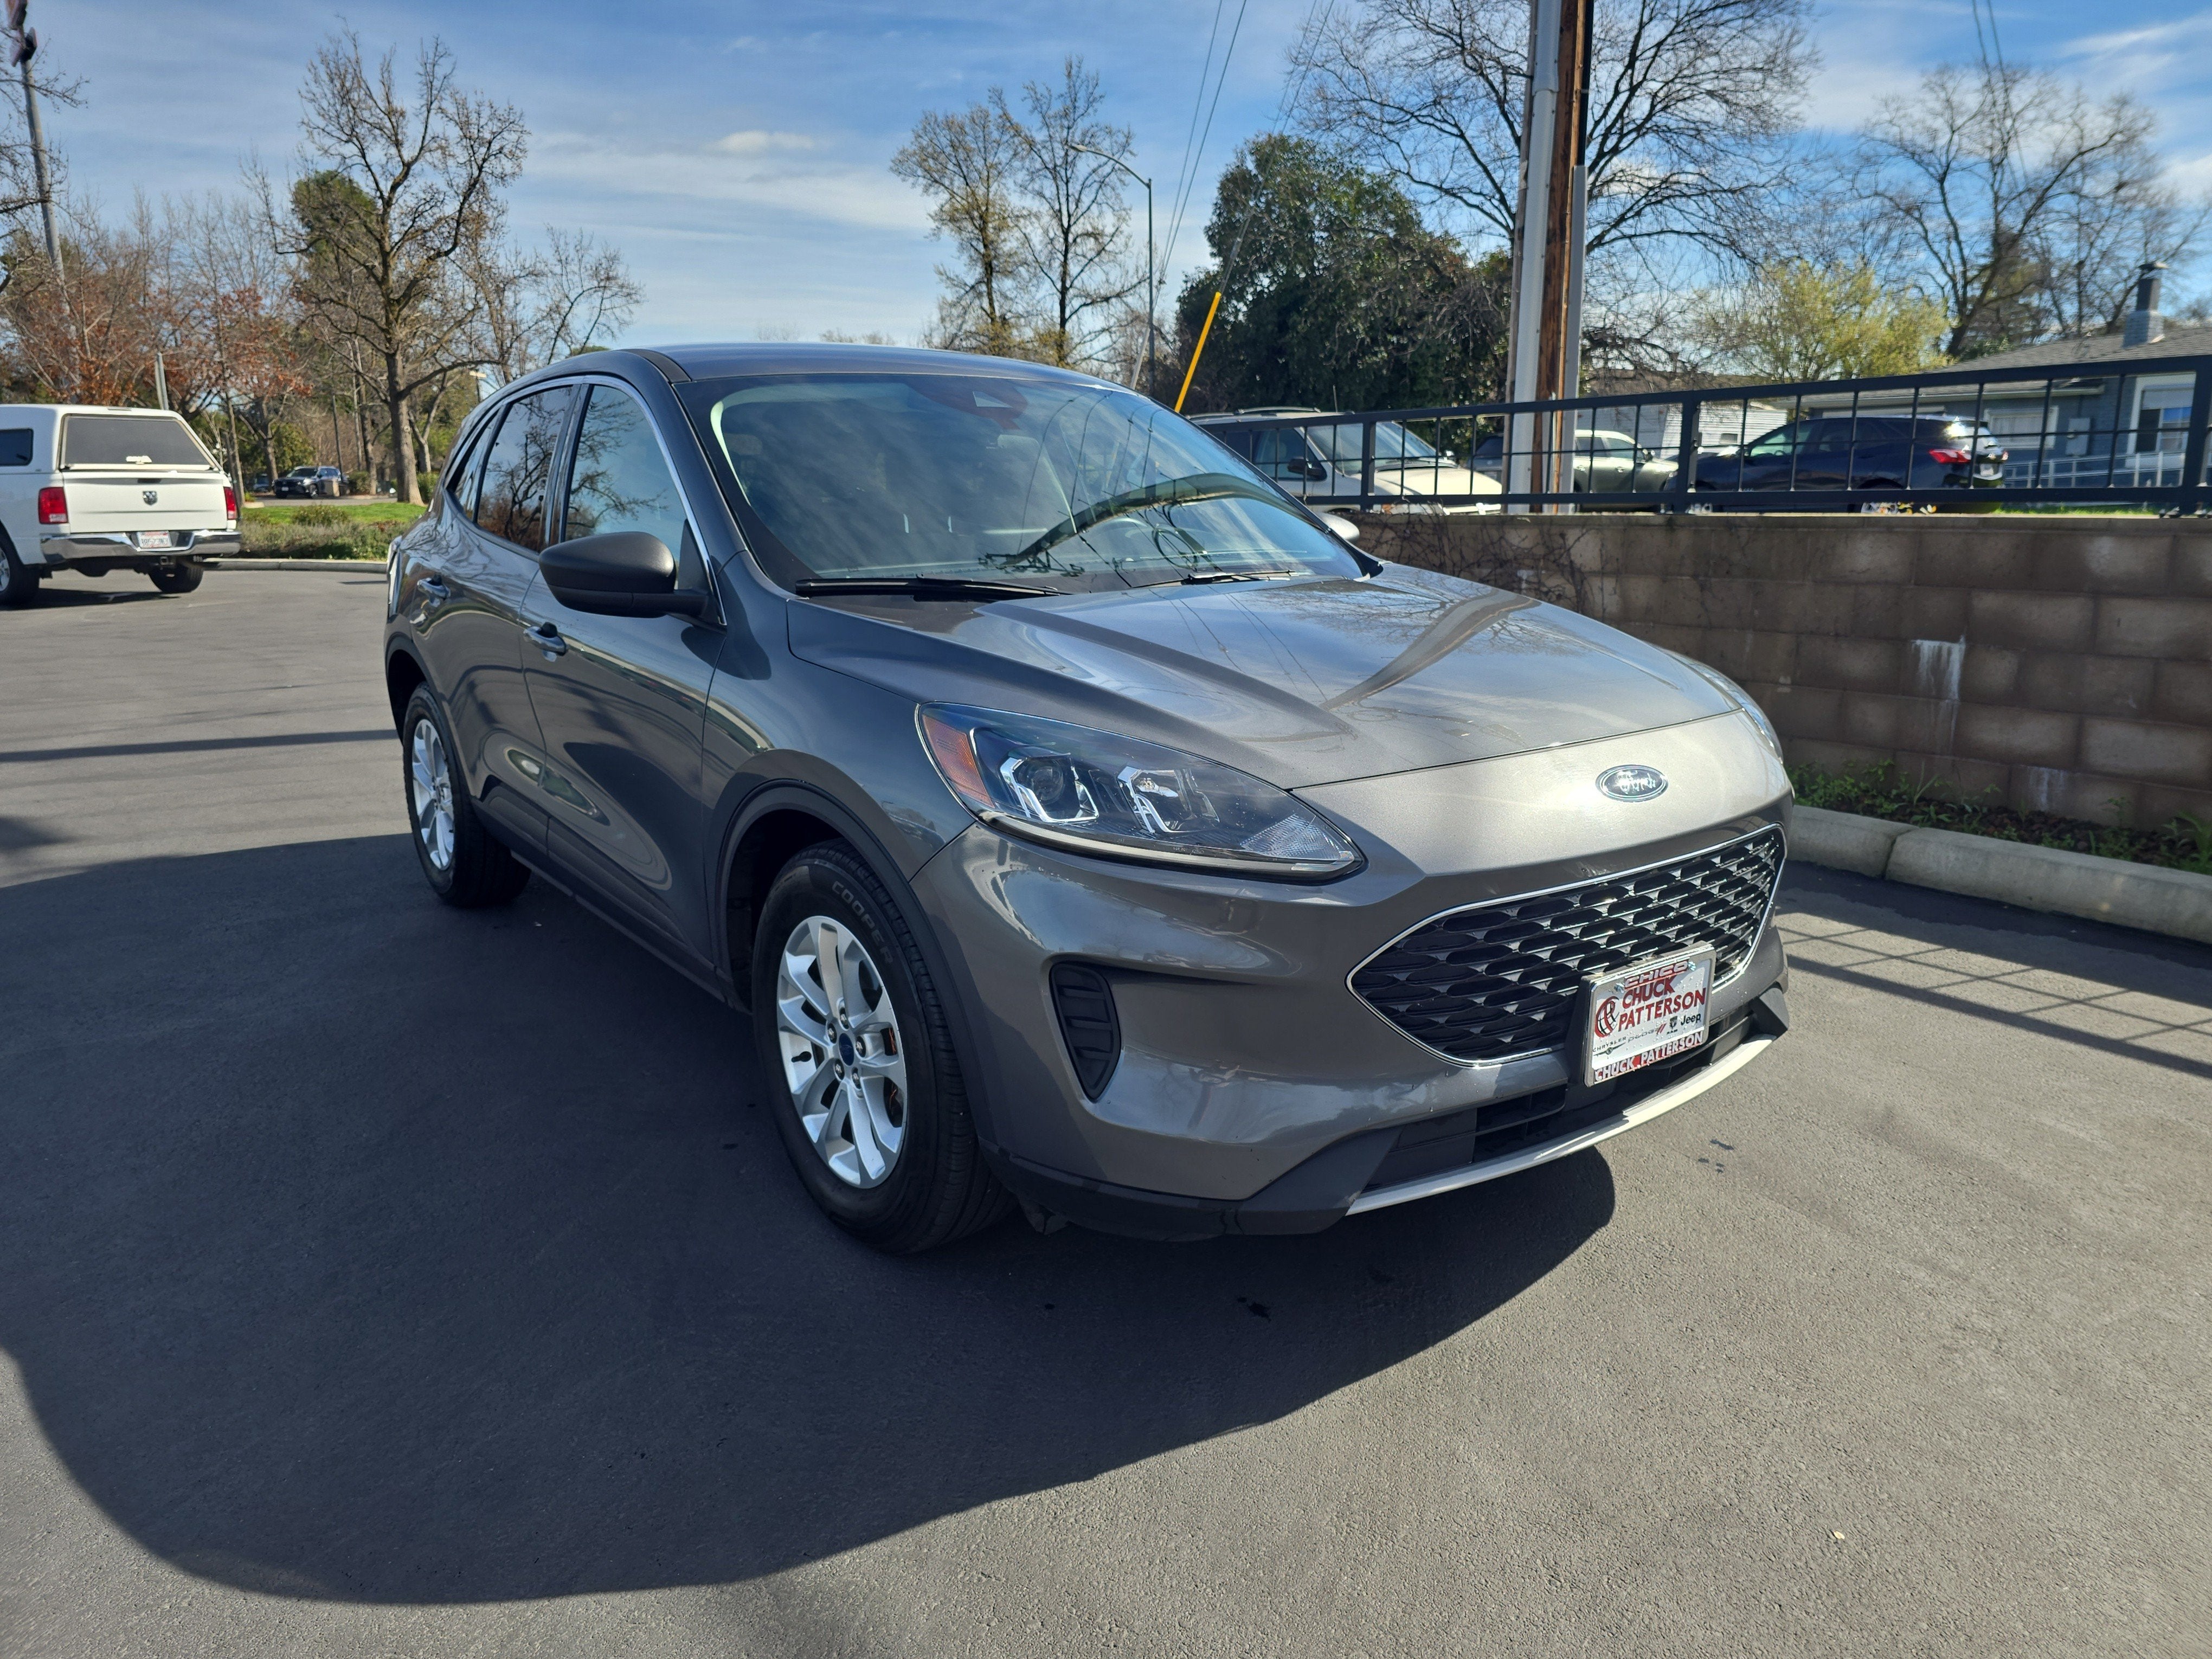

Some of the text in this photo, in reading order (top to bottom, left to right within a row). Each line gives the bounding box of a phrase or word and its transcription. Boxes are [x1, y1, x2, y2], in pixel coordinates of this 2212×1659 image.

[832, 880, 893, 963] COOPER
[1624, 961, 1688, 988] CHICO
[1622, 976, 1675, 1009] CHUCK
[1618, 988, 1706, 1031] PATTERSON
[1681, 1013, 1701, 1026] Jeep
[1592, 1037, 1626, 1052] CHRYSLER
[1595, 1031, 1703, 1082] CHUCK PATTERSON
